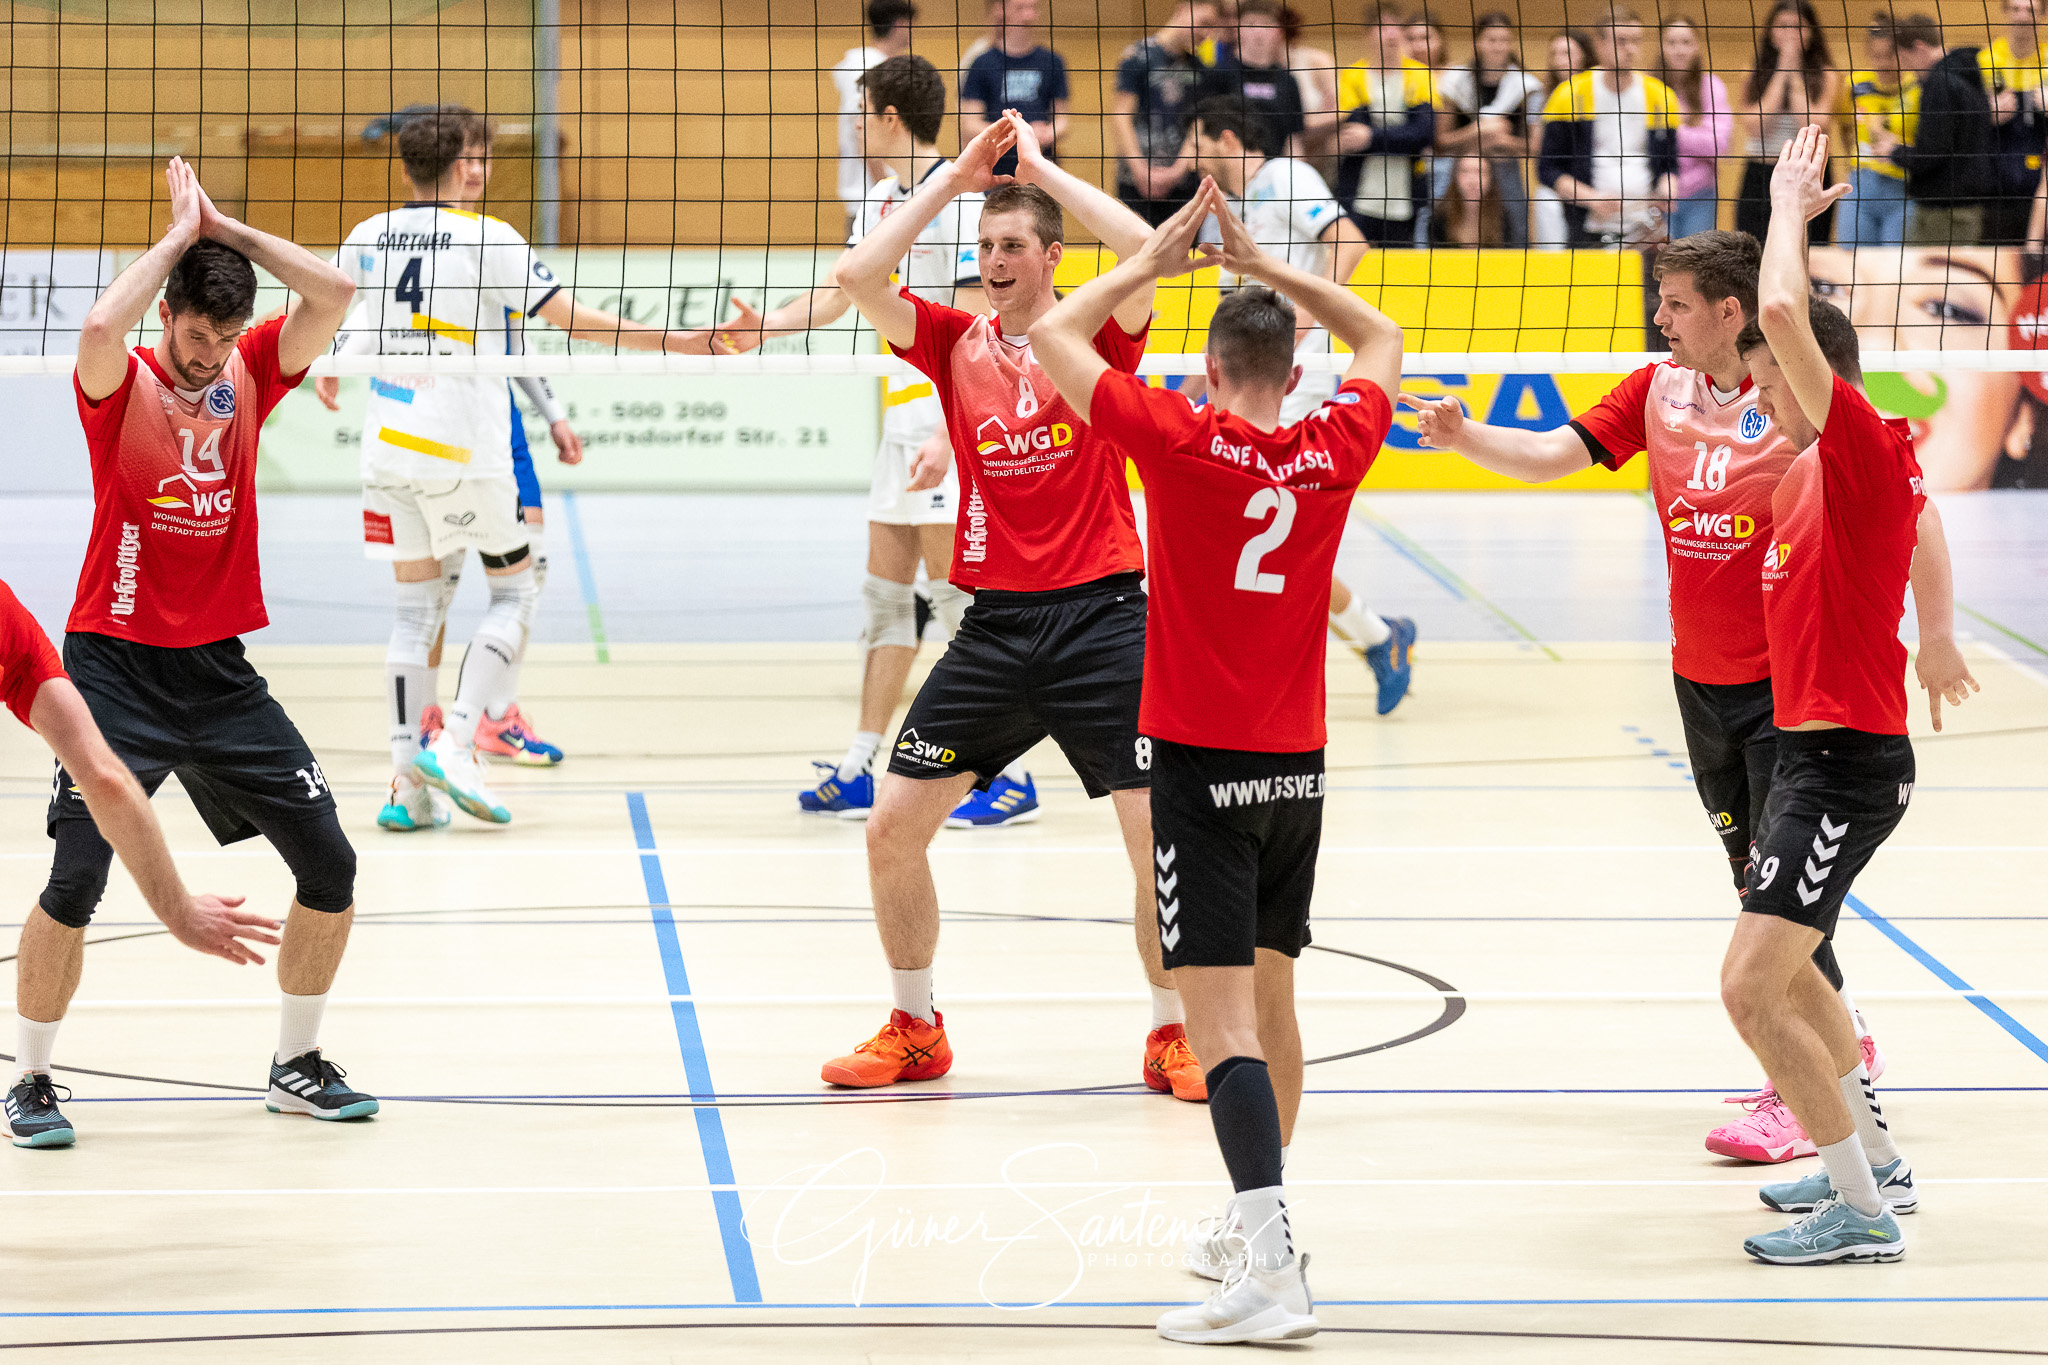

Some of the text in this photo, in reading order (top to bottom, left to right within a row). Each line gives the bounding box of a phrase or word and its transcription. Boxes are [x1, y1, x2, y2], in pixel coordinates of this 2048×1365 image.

[395, 257, 423, 313] 4
[1016, 375, 1039, 419] 8
[178, 428, 226, 481] 14
[1004, 423, 1073, 455] WGD
[1014, 463, 1056, 476] DELITZSCH
[1686, 441, 1732, 491] 18
[192, 486, 236, 516] WG
[151, 522, 168, 531] DER
[168, 526, 194, 536] STADT
[1234, 486, 1297, 594] 2
[1694, 512, 1755, 538] WGD
[1694, 552, 1731, 561] DELITZSCH
[913, 740, 956, 763] SWD
[1135, 736, 1153, 770] 8
[296, 761, 329, 799] 14
[1209, 772, 1326, 809] WWW.GSVE.D
[1756, 855, 1780, 890] 9
